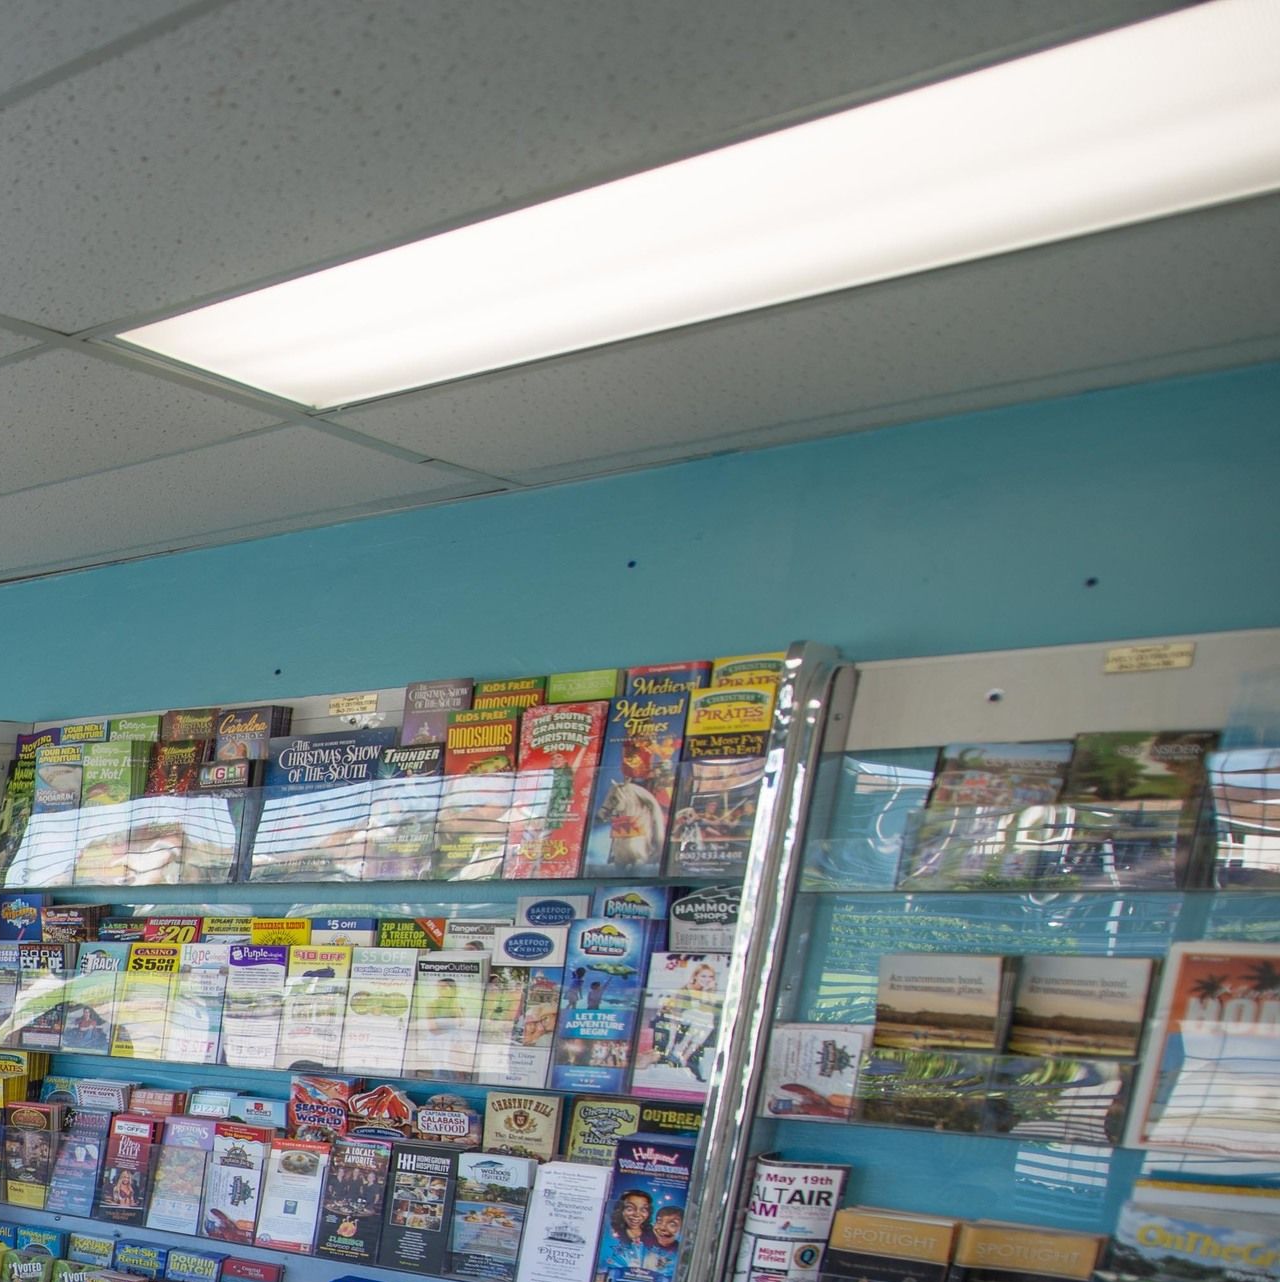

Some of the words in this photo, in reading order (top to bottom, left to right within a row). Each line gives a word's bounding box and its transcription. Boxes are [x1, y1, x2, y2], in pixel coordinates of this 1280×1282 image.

[455, 712, 481, 723] KIDS
[483, 709, 510, 720] FREE!
[615, 699, 683, 723] Medieval
[693, 706, 763, 724] PIRATES
[533, 714, 550, 725] THE
[624, 718, 670, 735] Times
[532, 722, 592, 736] GRANDEST
[448, 725, 513, 749] DINOSAURS
[529, 732, 591, 749] CHRISTMAS
[543, 742, 576, 753] SHOW
[83, 755, 120, 768] Believe
[279, 748, 341, 770] CHRISTMAS
[347, 743, 383, 762] SHOW
[383, 748, 440, 763] THUNDER
[288, 767, 302, 783] OF
[694, 912, 728, 920] SHOPS
[382, 922, 394, 931] ZIP
[397, 922, 415, 932] LINE
[389, 931, 426, 940] TREETOP
[381, 938, 428, 949] ADVENTURE
[20, 949, 62, 958] ROOM
[137, 948, 174, 956] CASINO
[419, 962, 479, 973] TangerOutlets
[575, 1013, 594, 1022] LET
[596, 1013, 617, 1021] THE
[566, 1019, 625, 1031] ADVENTURE
[579, 1027, 609, 1036] BEGIN
[295, 1102, 344, 1117] SEAFOOD
[491, 1097, 530, 1113] CHESTNUT
[534, 1099, 555, 1118] HILL
[296, 1113, 342, 1126] WORLD
[420, 1116, 466, 1126] CALABASH
[642, 1108, 702, 1127] OUTBREA
[420, 1122, 466, 1136] SEAFOOD
[765, 1172, 795, 1186] May
[802, 1174, 834, 1186] 19th
[842, 1226, 937, 1250] SPOTLIGHT
[976, 1241, 1082, 1266] SPOTLIGHT
[19, 1262, 42, 1274] VOTED
[170, 1254, 215, 1268] DOLPHIN
